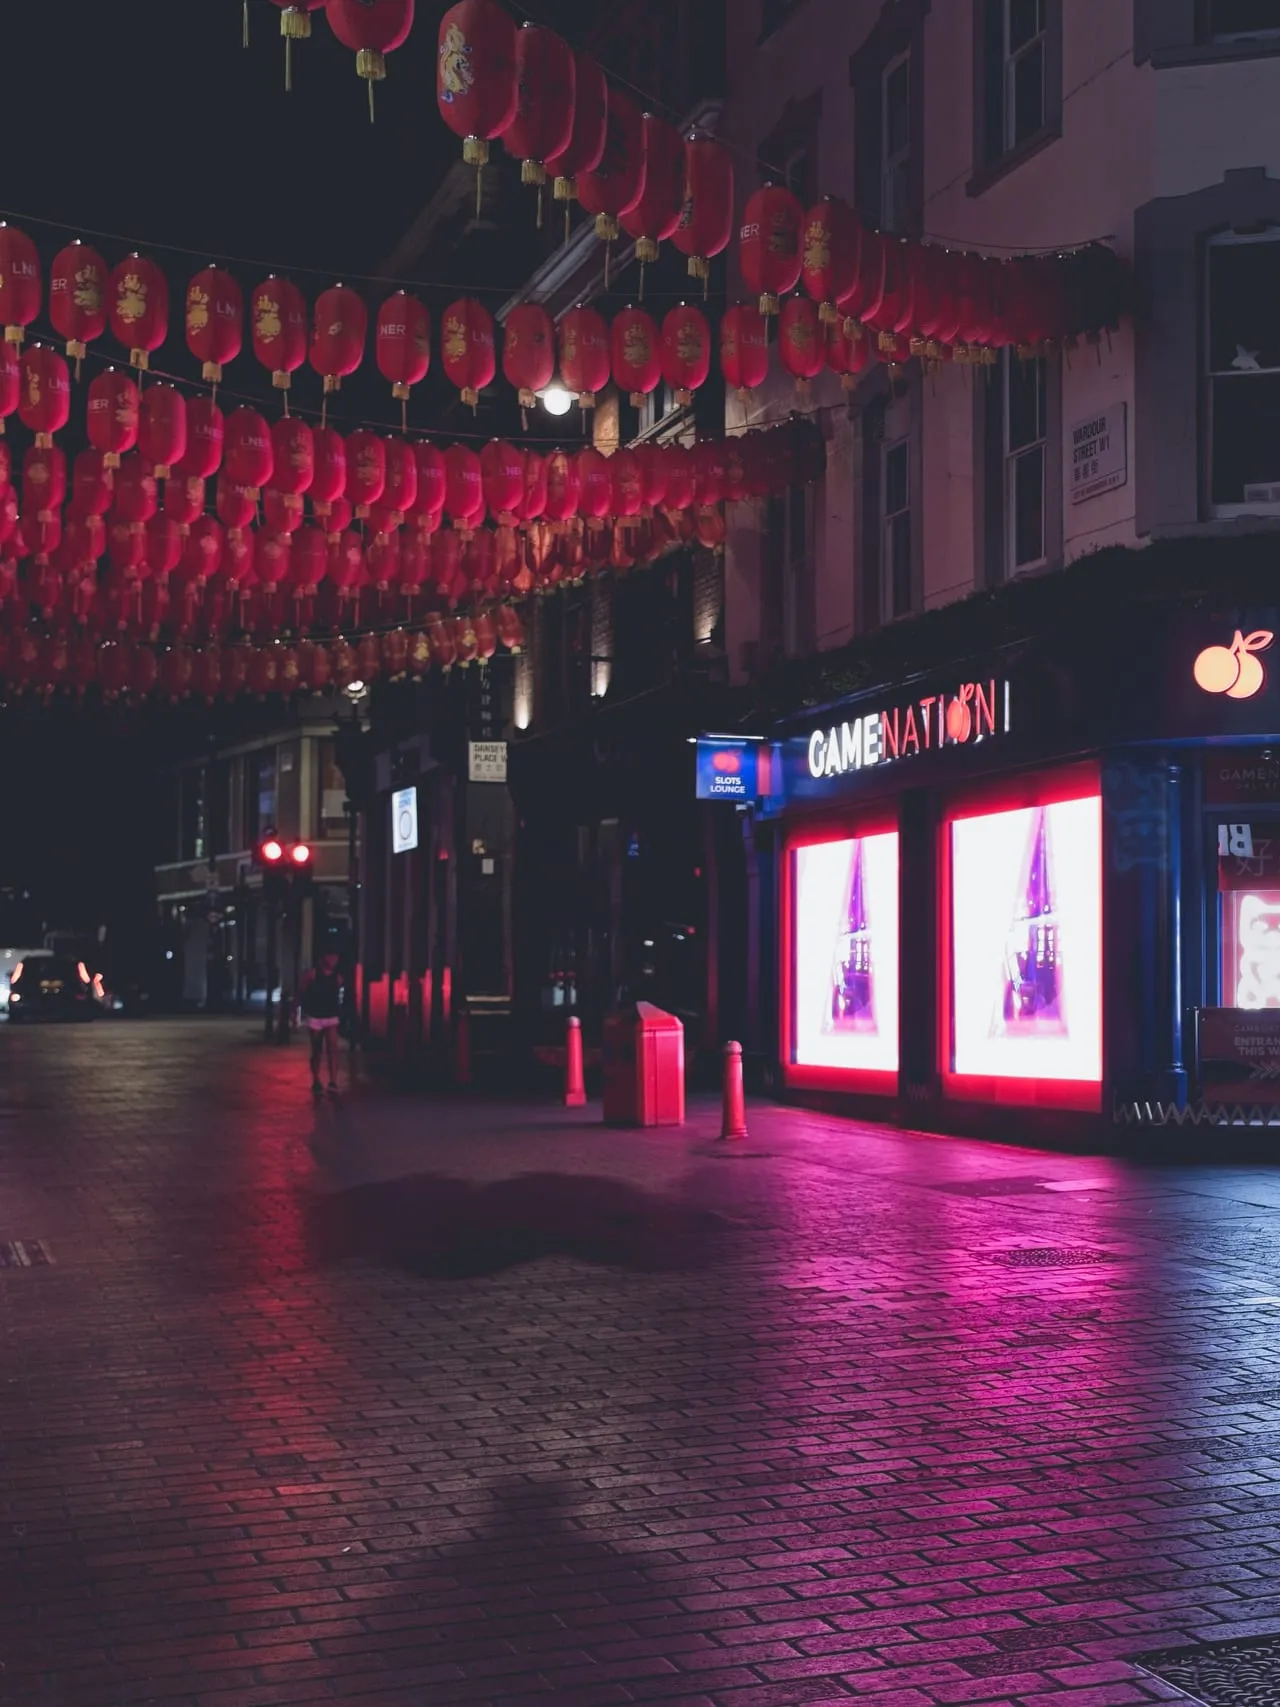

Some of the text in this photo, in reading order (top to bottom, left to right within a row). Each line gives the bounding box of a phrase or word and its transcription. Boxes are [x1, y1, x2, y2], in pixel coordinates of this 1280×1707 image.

[1073, 440, 1097, 464] STREET
[715, 776, 742, 785] SLOTS
[710, 784, 746, 794] LOUNGE
[1237, 1046, 1266, 1056] THIS
